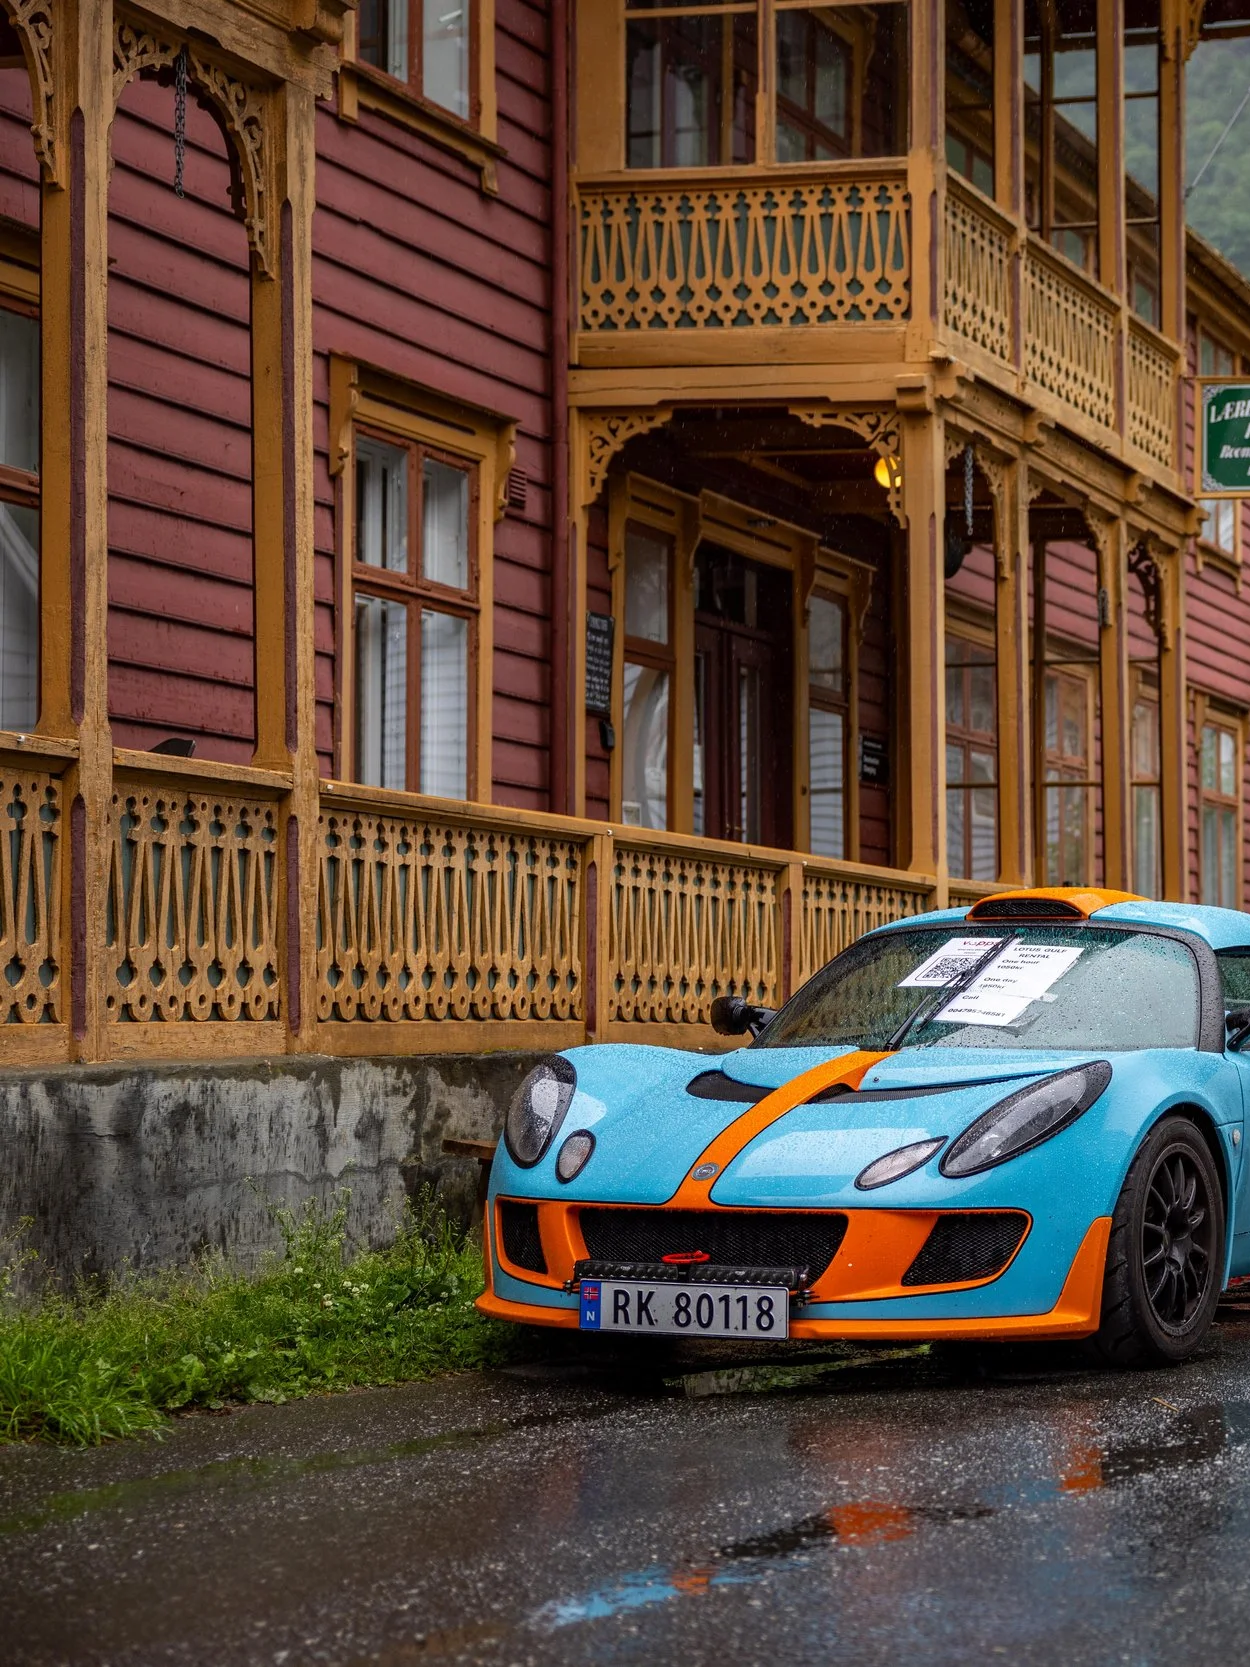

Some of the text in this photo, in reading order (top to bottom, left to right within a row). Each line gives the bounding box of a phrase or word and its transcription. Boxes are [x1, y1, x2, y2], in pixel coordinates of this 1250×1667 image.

[586, 1311, 596, 1322] N
[612, 1289, 775, 1332] RK 80118
